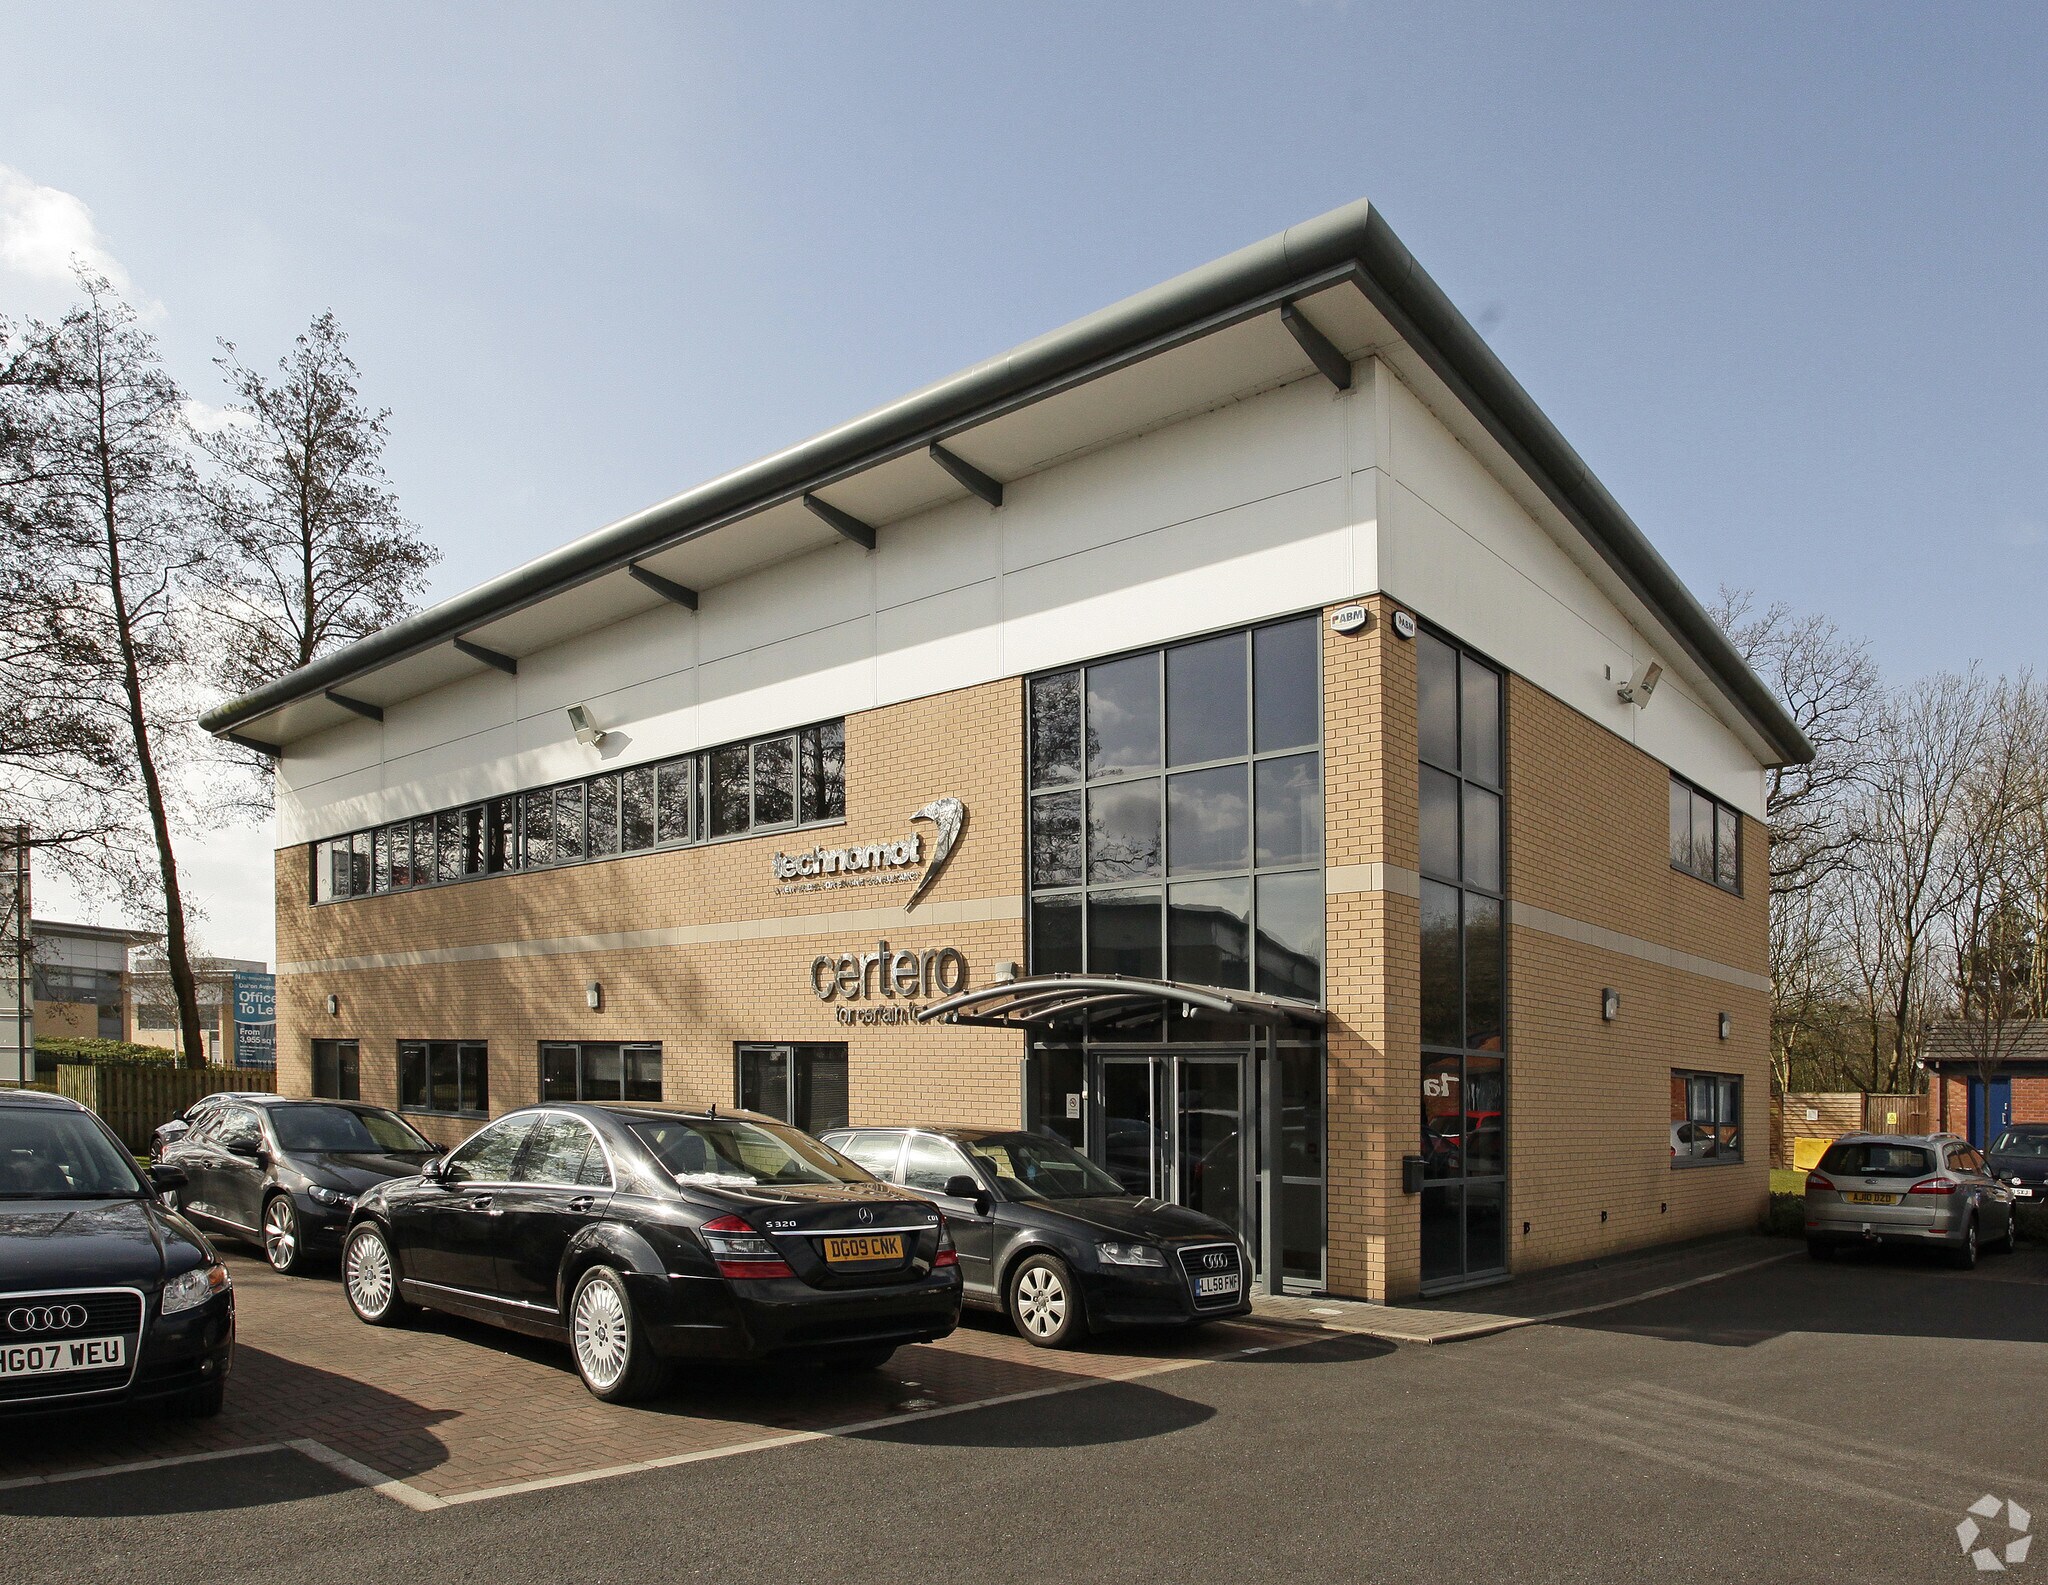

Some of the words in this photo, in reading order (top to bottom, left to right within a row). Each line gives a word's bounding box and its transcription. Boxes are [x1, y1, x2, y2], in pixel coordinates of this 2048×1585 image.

[810, 940, 965, 999] certero
[239, 1002, 255, 1014] To
[258, 1003, 276, 1015] Le
[240, 1028, 260, 1036] From
[775, 1220, 797, 1228] 320
[831, 1238, 869, 1258] DG09
[871, 1237, 898, 1255] CNK
[1200, 1277, 1223, 1292] LL58
[70, 1340, 119, 1366] WEU
